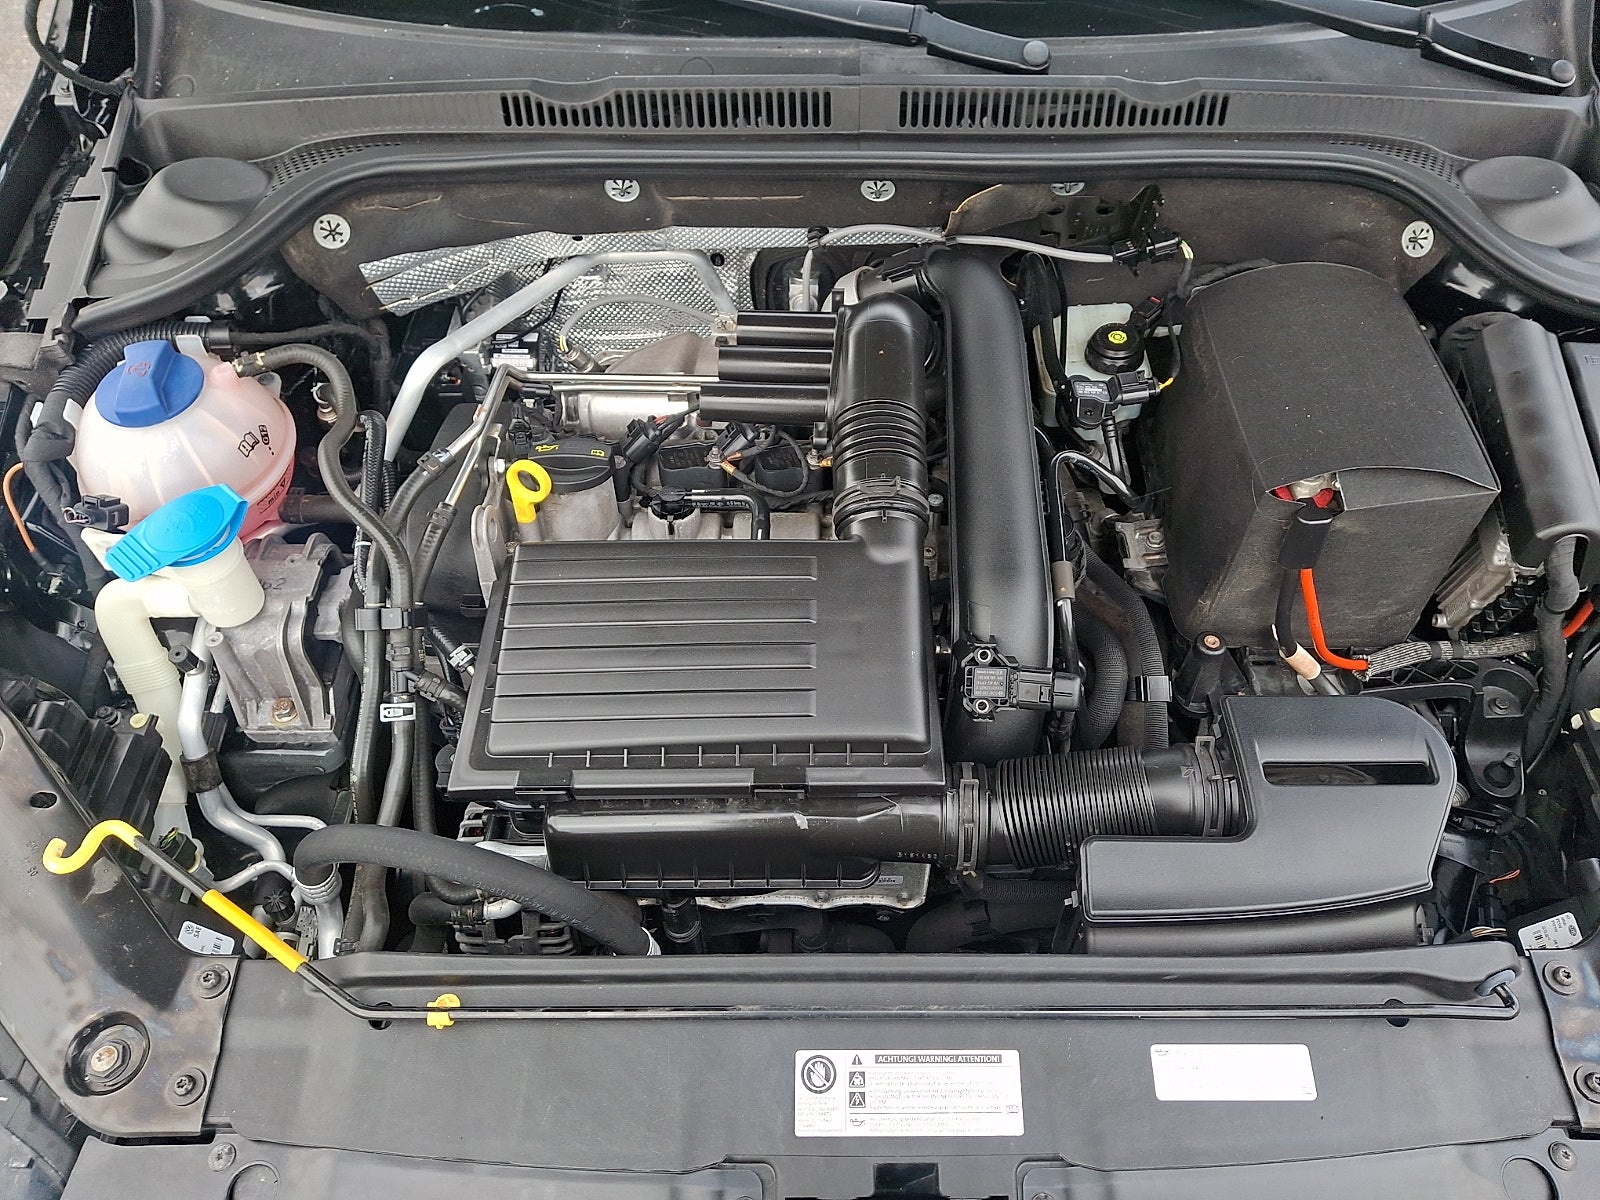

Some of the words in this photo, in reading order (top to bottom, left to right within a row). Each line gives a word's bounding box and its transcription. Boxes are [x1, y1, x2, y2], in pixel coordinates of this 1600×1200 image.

[193, 926, 202, 938] SAE
[878, 1055, 917, 1063] ACHTUNG!
[918, 1055, 956, 1063] WARNING!
[957, 1055, 1001, 1063] ATTENTION!
